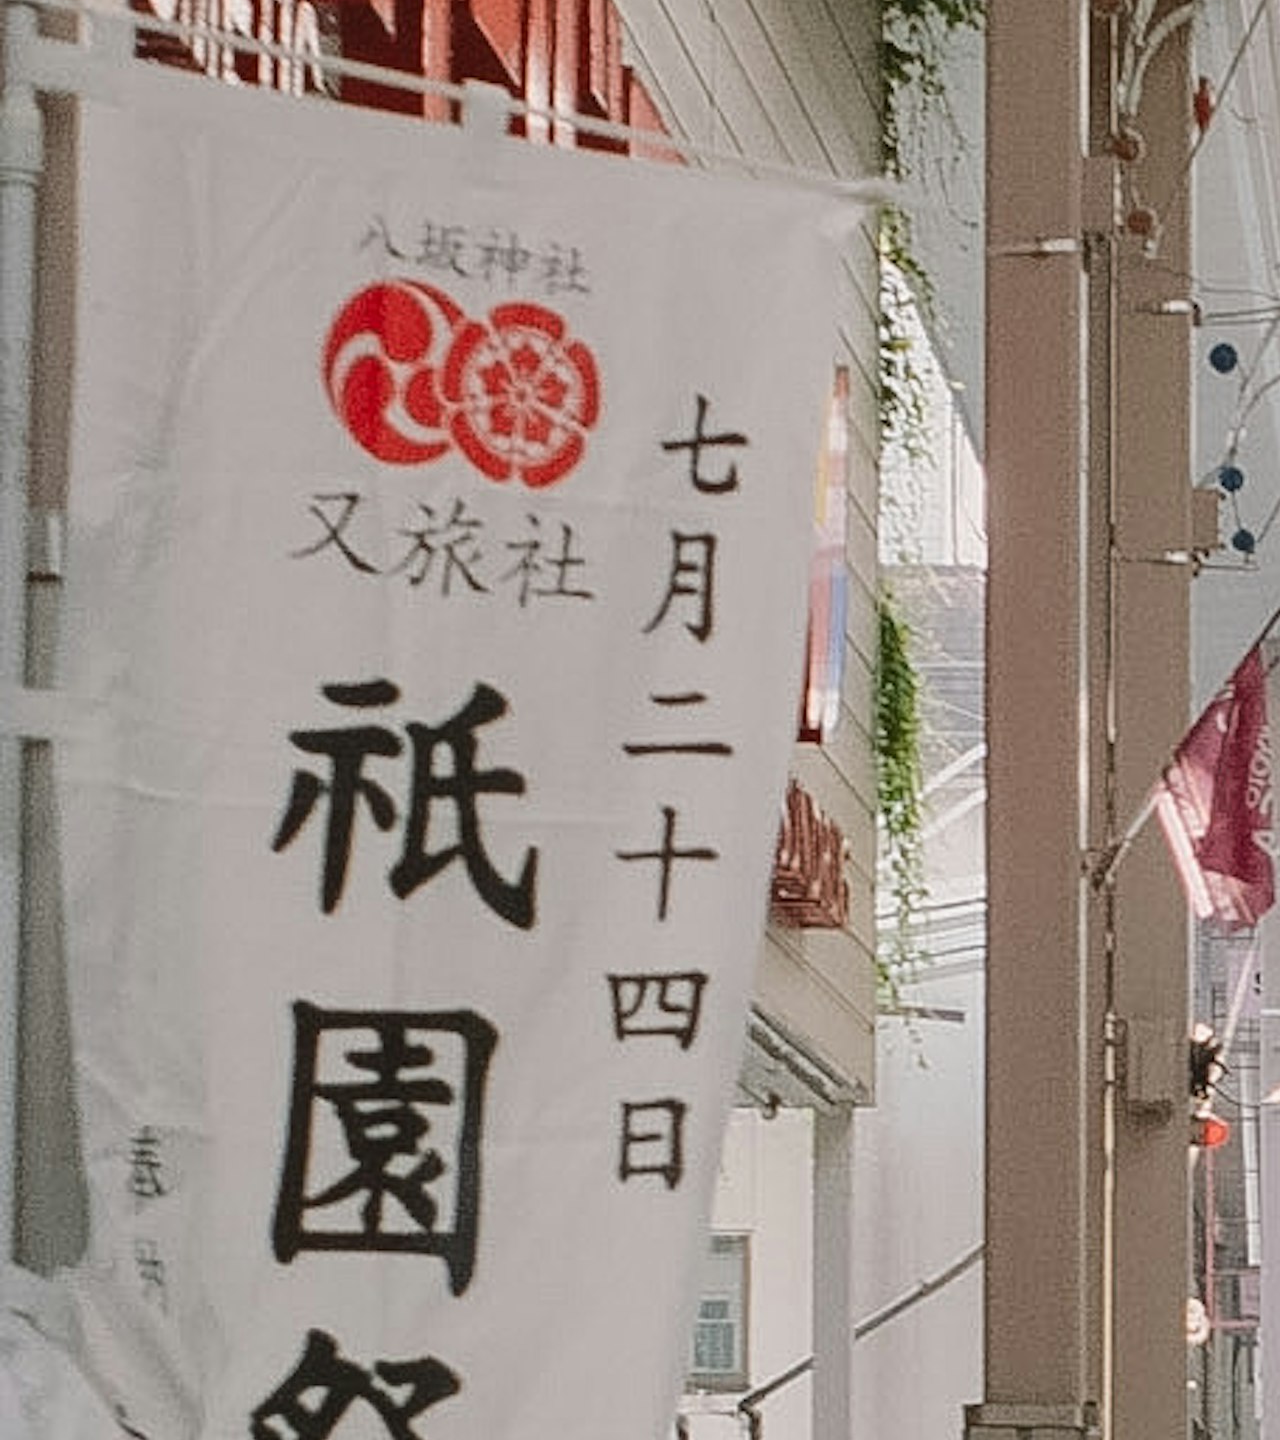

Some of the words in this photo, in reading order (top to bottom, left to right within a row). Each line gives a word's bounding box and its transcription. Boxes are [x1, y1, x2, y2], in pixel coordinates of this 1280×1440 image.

[358, 213, 592, 296] 八坂神社
[288, 491, 595, 608] 又旅社
[605, 393, 749, 1191] 七月二十四日
